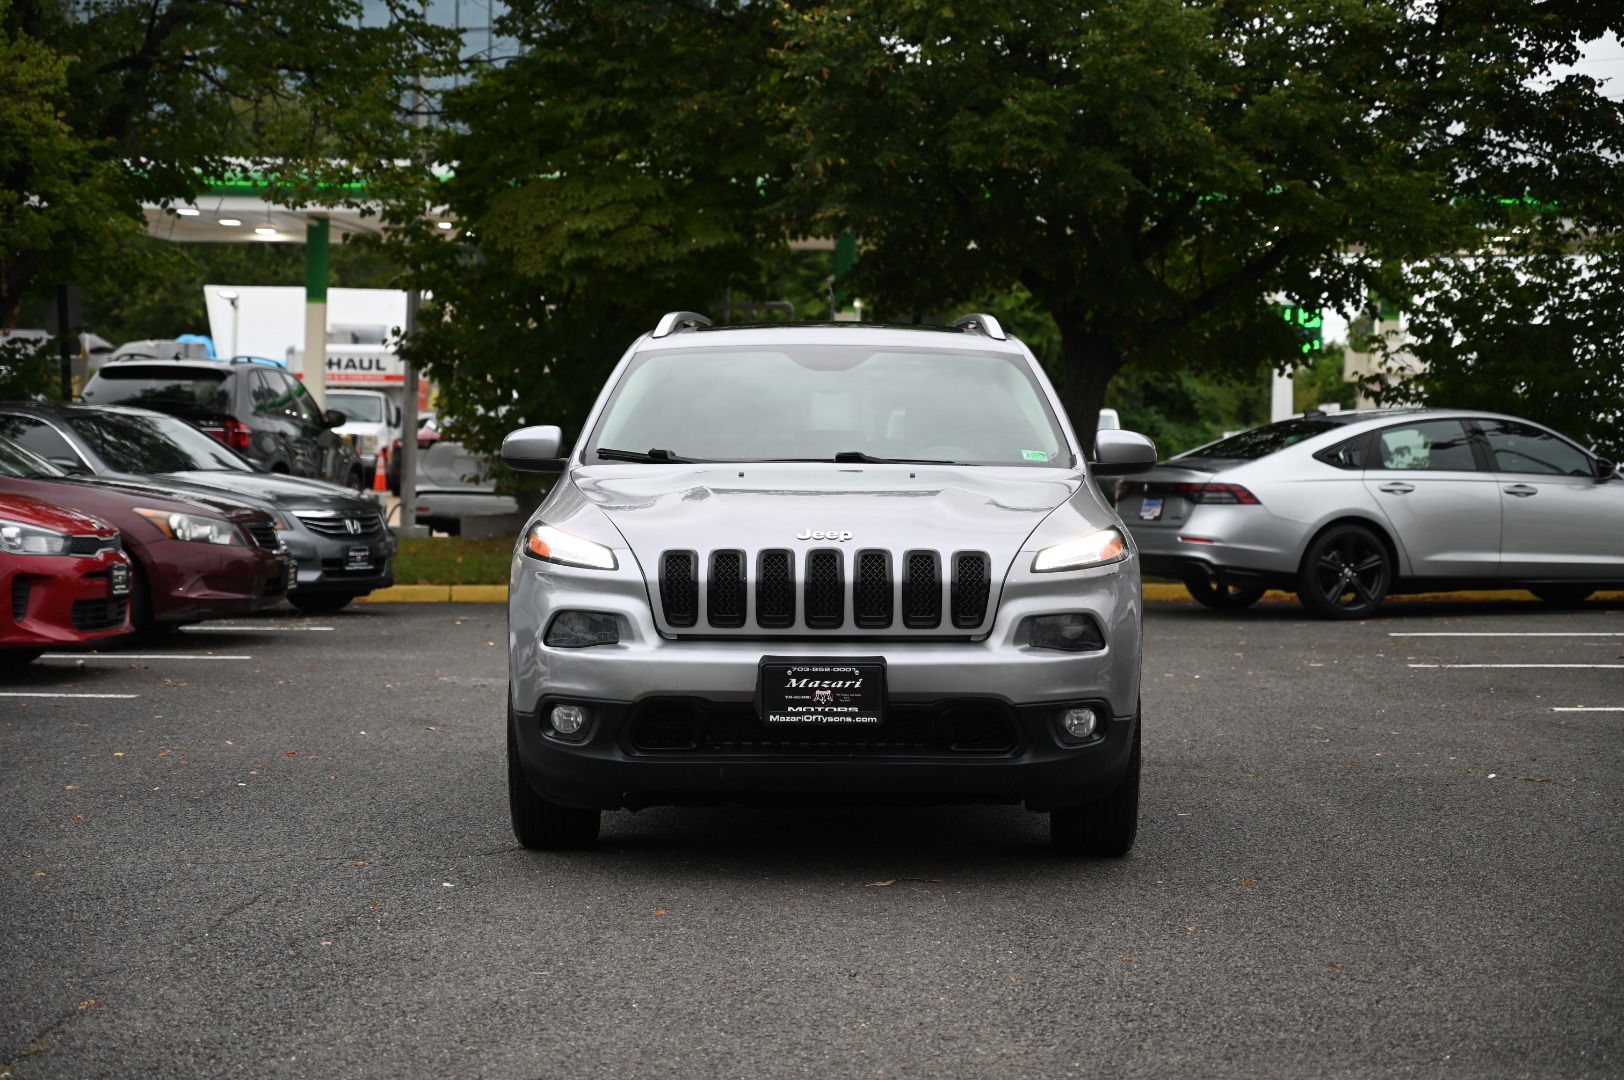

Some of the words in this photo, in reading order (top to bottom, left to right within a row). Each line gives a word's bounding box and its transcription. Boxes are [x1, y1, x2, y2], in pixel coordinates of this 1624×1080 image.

[796, 528, 853, 542] Jeep
[784, 678, 863, 689] Mazari
[769, 715, 877, 723] MazariOfTysons.com
